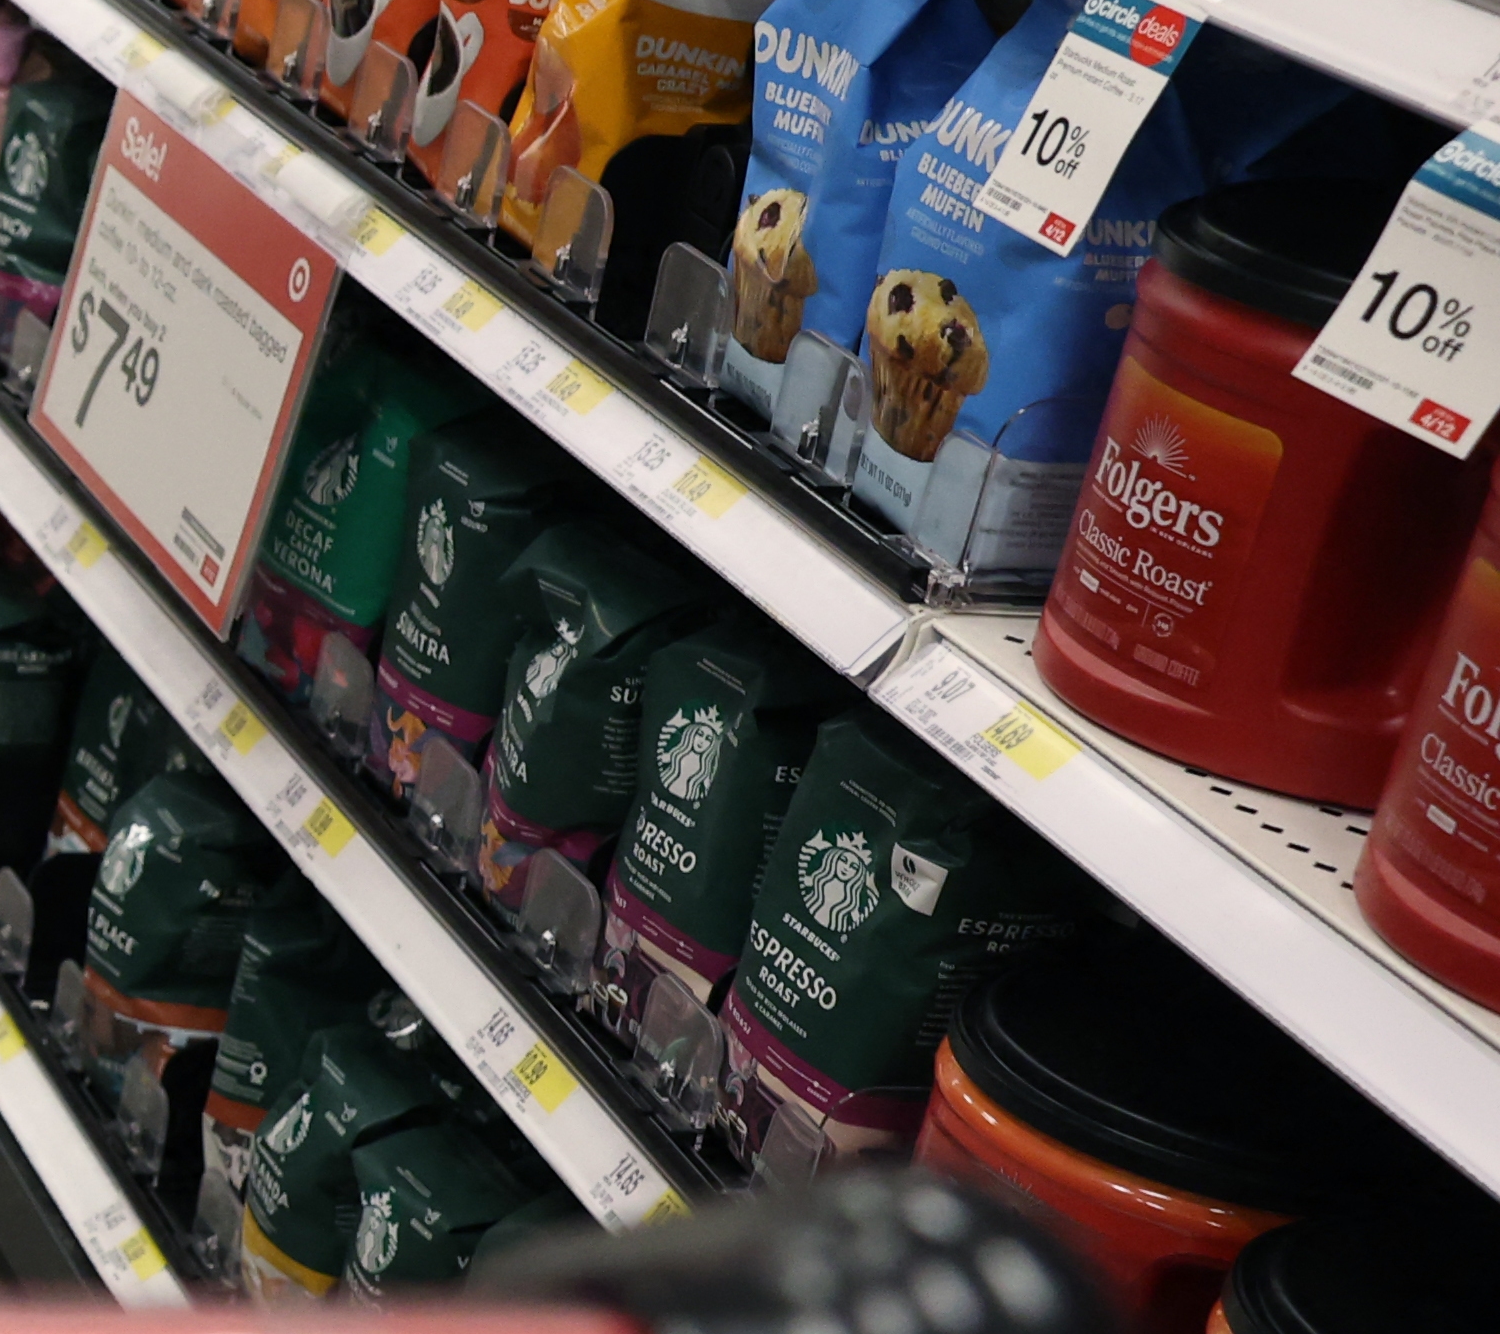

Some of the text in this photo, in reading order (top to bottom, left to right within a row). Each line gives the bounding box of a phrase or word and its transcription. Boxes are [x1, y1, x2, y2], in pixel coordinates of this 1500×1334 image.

[1139, 16, 1178, 47] deals
[120, 116, 168, 183] Sale!
[1020, 109, 1090, 167] 10%
[1054, 160, 1080, 180] off
[919, 183, 984, 234] MUFFIN
[1045, 224, 1065, 242] 4/12
[1360, 270, 1474, 342] 10%
[1422, 335, 1464, 361] off
[1095, 436, 1224, 547] Folgers
[286, 513, 335, 552] DECAF
[1078, 508, 1131, 568] Classic
[1132, 548, 1213, 607] Roast
[273, 535, 334, 595] VERONA
[632, 846, 667, 879] ROAST
[781, 911, 841, 964] STARBUCKS
[749, 919, 837, 1012] ESPRESSO
[757, 965, 802, 1010] ROAST
[611, 1153, 647, 1197] 14.65
